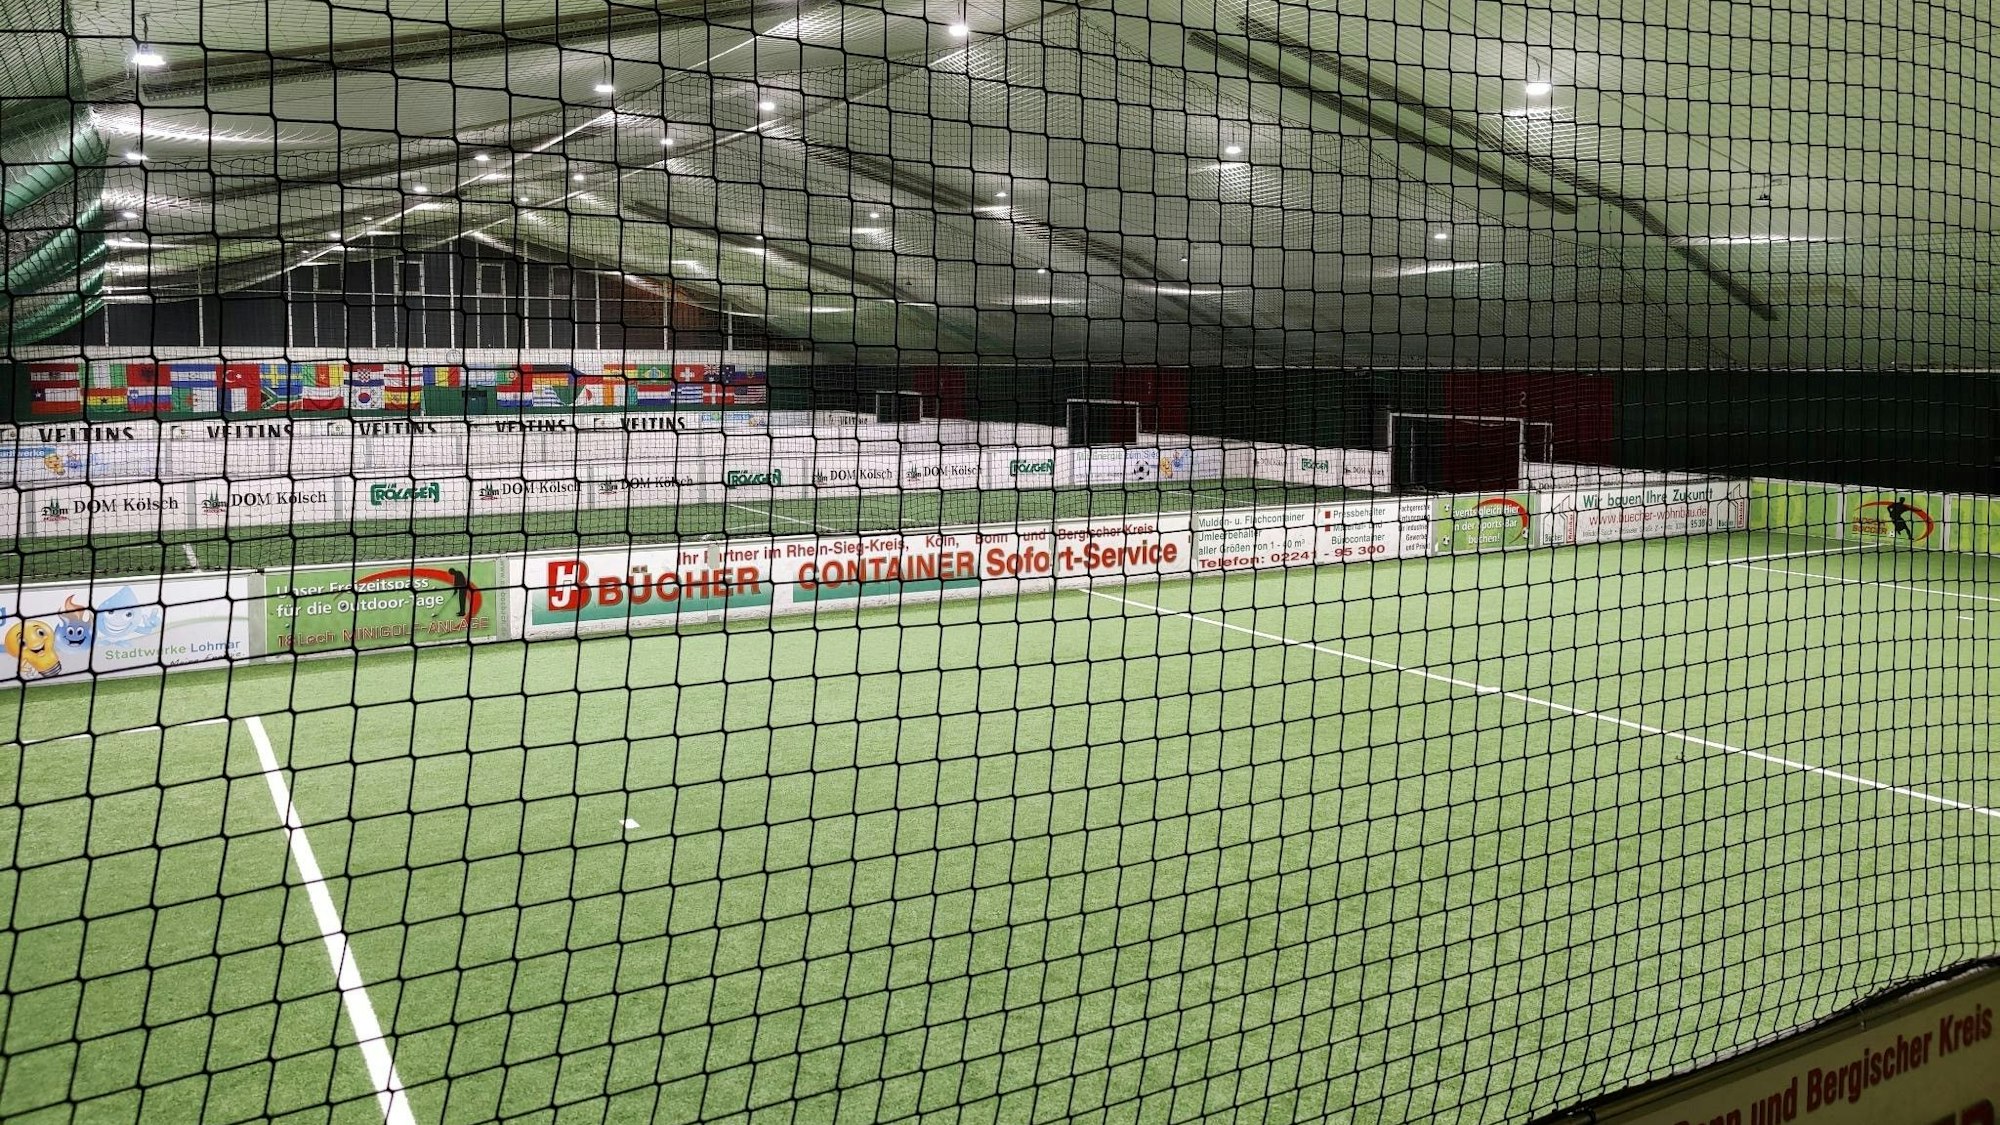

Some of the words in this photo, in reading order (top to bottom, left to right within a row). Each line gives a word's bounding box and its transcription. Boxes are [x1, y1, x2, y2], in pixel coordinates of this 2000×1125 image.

[830, 469, 856, 480] DOM
[860, 468, 893, 479] Kölsch
[924, 466, 948, 477] DOM
[502, 483, 535, 495] DOM
[540, 480, 581, 493] Kölsch
[622, 477, 650, 490] DOM
[655, 475, 693, 488] Kölch
[73, 499, 116, 514] DOM
[124, 496, 178, 512] Kölsch
[232, 493, 271, 507] DOM
[276, 490, 327, 504] Kölsch
[1583, 494, 1602, 508] Wir
[1607, 492, 1641, 507] bauen
[1646, 489, 1667, 503] Ihre
[1479, 504, 1502, 517] gleich
[1504, 503, 1520, 514] Hier
[1462, 520, 1475, 530] der
[1477, 518, 1518, 532] ports-Bar
[678, 551, 699, 566] Ihr
[764, 546, 782, 559] im
[786, 537, 909, 558] Rhen-Sieg-Kreis,
[926, 533, 959, 549] Köln,
[975, 533, 1008, 545] Bonn
[1023, 528, 1046, 541] und
[1058, 526, 1121, 542] Bergischer
[1125, 523, 1154, 535] Kreis
[1198, 546, 1217, 556] aller
[1252, 542, 1268, 551] on
[986, 539, 1178, 577] Sofort-Service
[1199, 555, 1265, 569] Telefon:
[1334, 547, 1353, 557] 95
[1358, 544, 1386, 555] 300
[597, 564, 762, 606] BÜCHER
[798, 550, 976, 592] CONTAINER
[276, 584, 324, 598] Unser
[277, 602, 301, 617] für
[307, 600, 332, 616] die
[105, 644, 187, 660] Stadtwrke
[190, 640, 241, 653] Lohmar
[1751, 1076, 1798, 1125] und
[1806, 1030, 1933, 1113] Bergischer
[1940, 1003, 1993, 1057] Kreis
